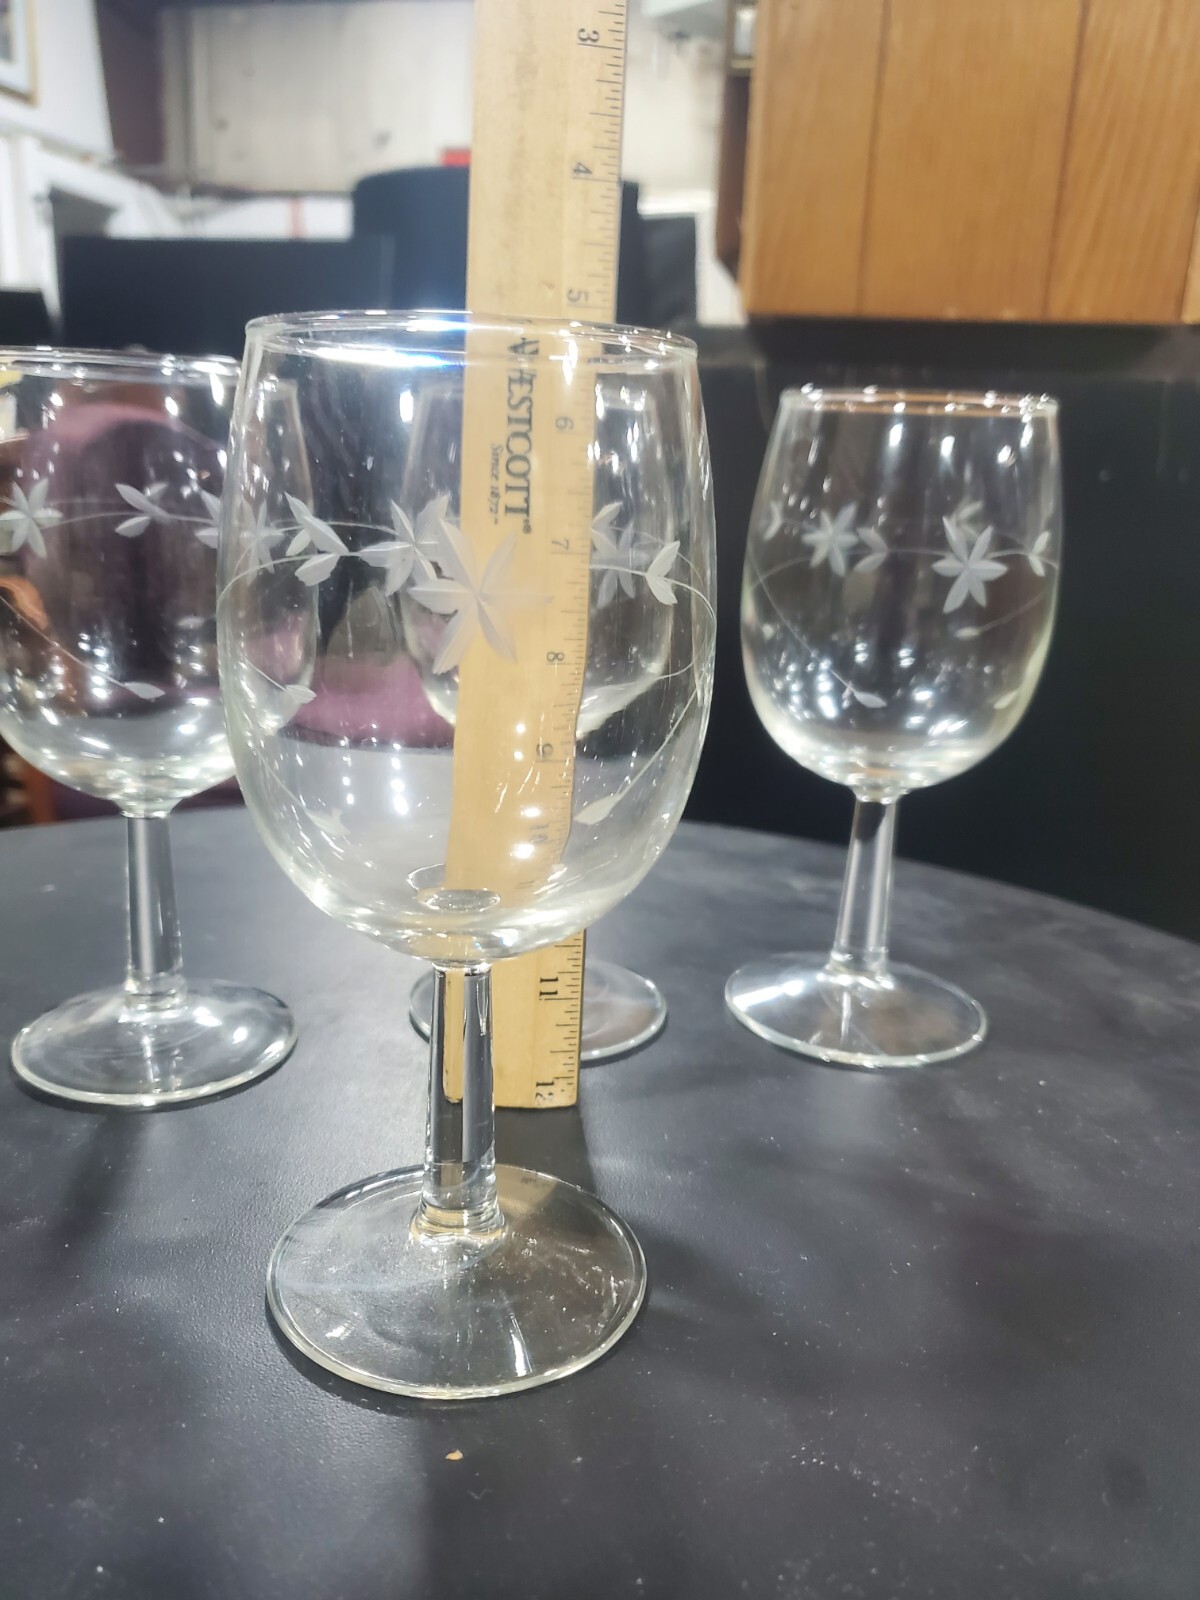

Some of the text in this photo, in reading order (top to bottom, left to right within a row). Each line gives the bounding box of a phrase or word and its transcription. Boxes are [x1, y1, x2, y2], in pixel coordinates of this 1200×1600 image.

[577, 27, 600, 44] 3
[572, 161, 593, 177] 4
[566, 288, 589, 304] 5
[555, 416, 574, 432] 6
[490, 444, 504, 480] Since
[551, 538, 570, 551] 7
[546, 650, 565, 663] 8
[535, 742, 554, 759] 9
[538, 976, 559, 998] 11
